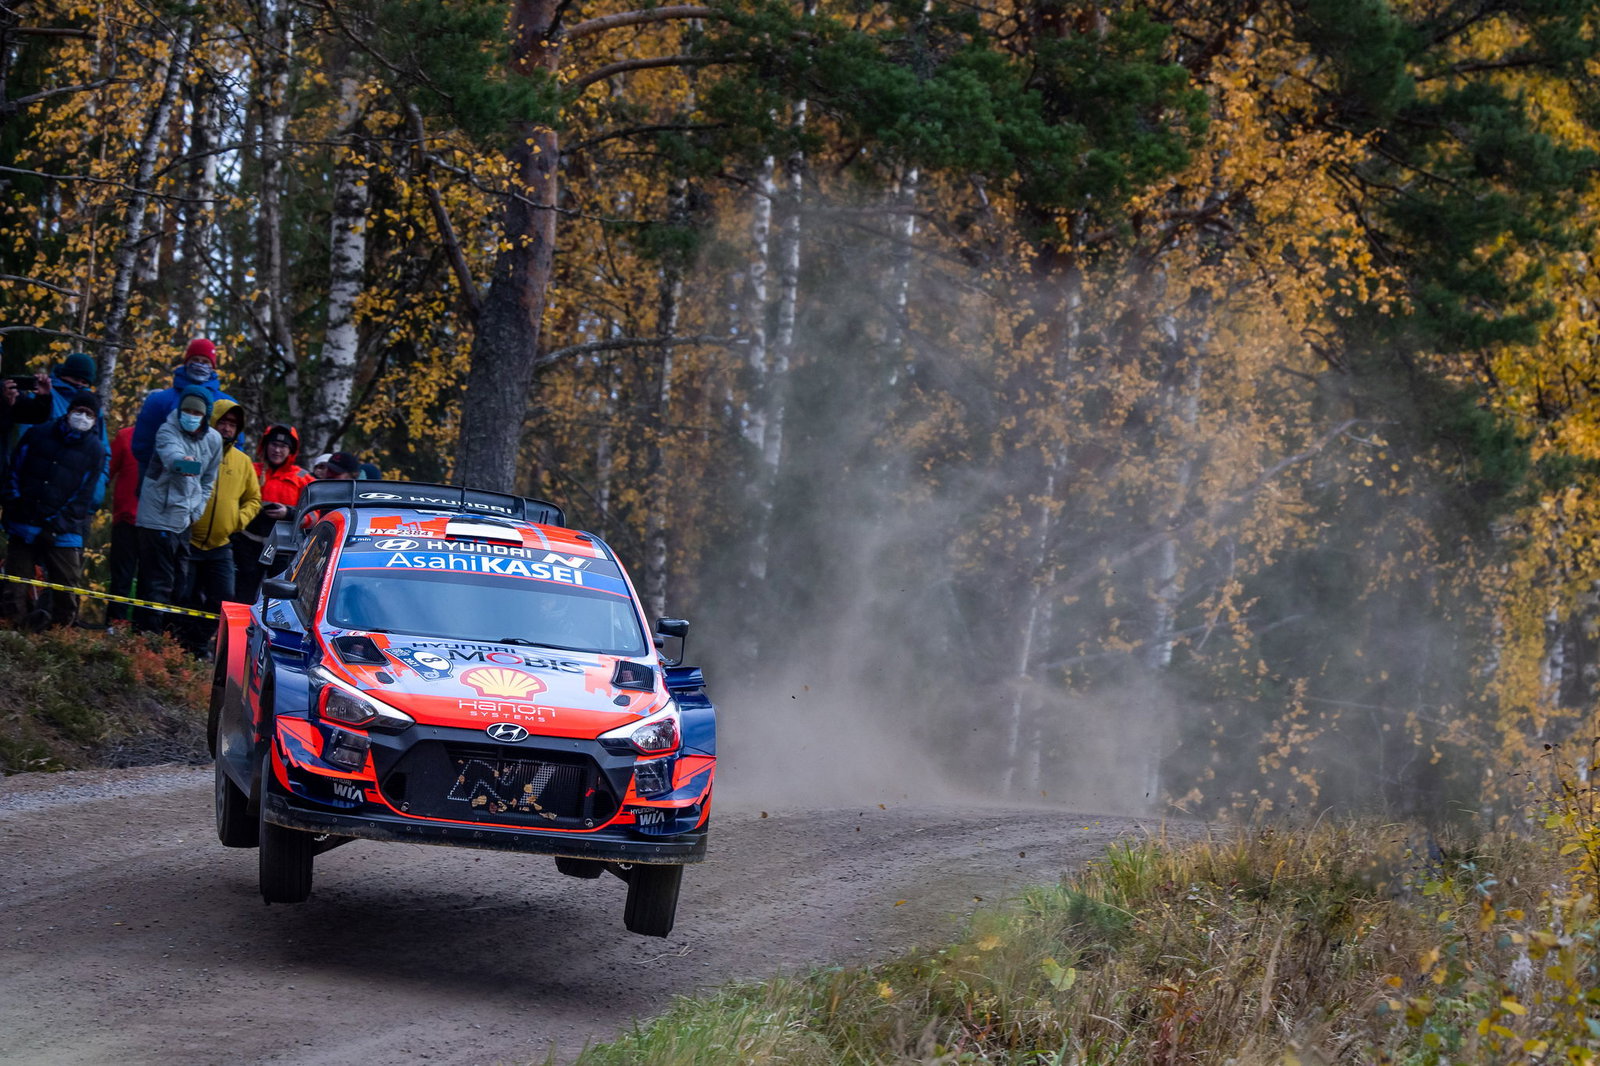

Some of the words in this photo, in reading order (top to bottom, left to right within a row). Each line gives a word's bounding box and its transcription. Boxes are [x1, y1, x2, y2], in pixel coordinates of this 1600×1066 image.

[410, 496, 512, 514] HYUNDAI
[427, 541, 532, 559] HYUNDAI
[412, 643, 516, 654] HYUNDAI
[449, 650, 585, 674] MOBIS
[470, 710, 545, 722] SYSTEMS
